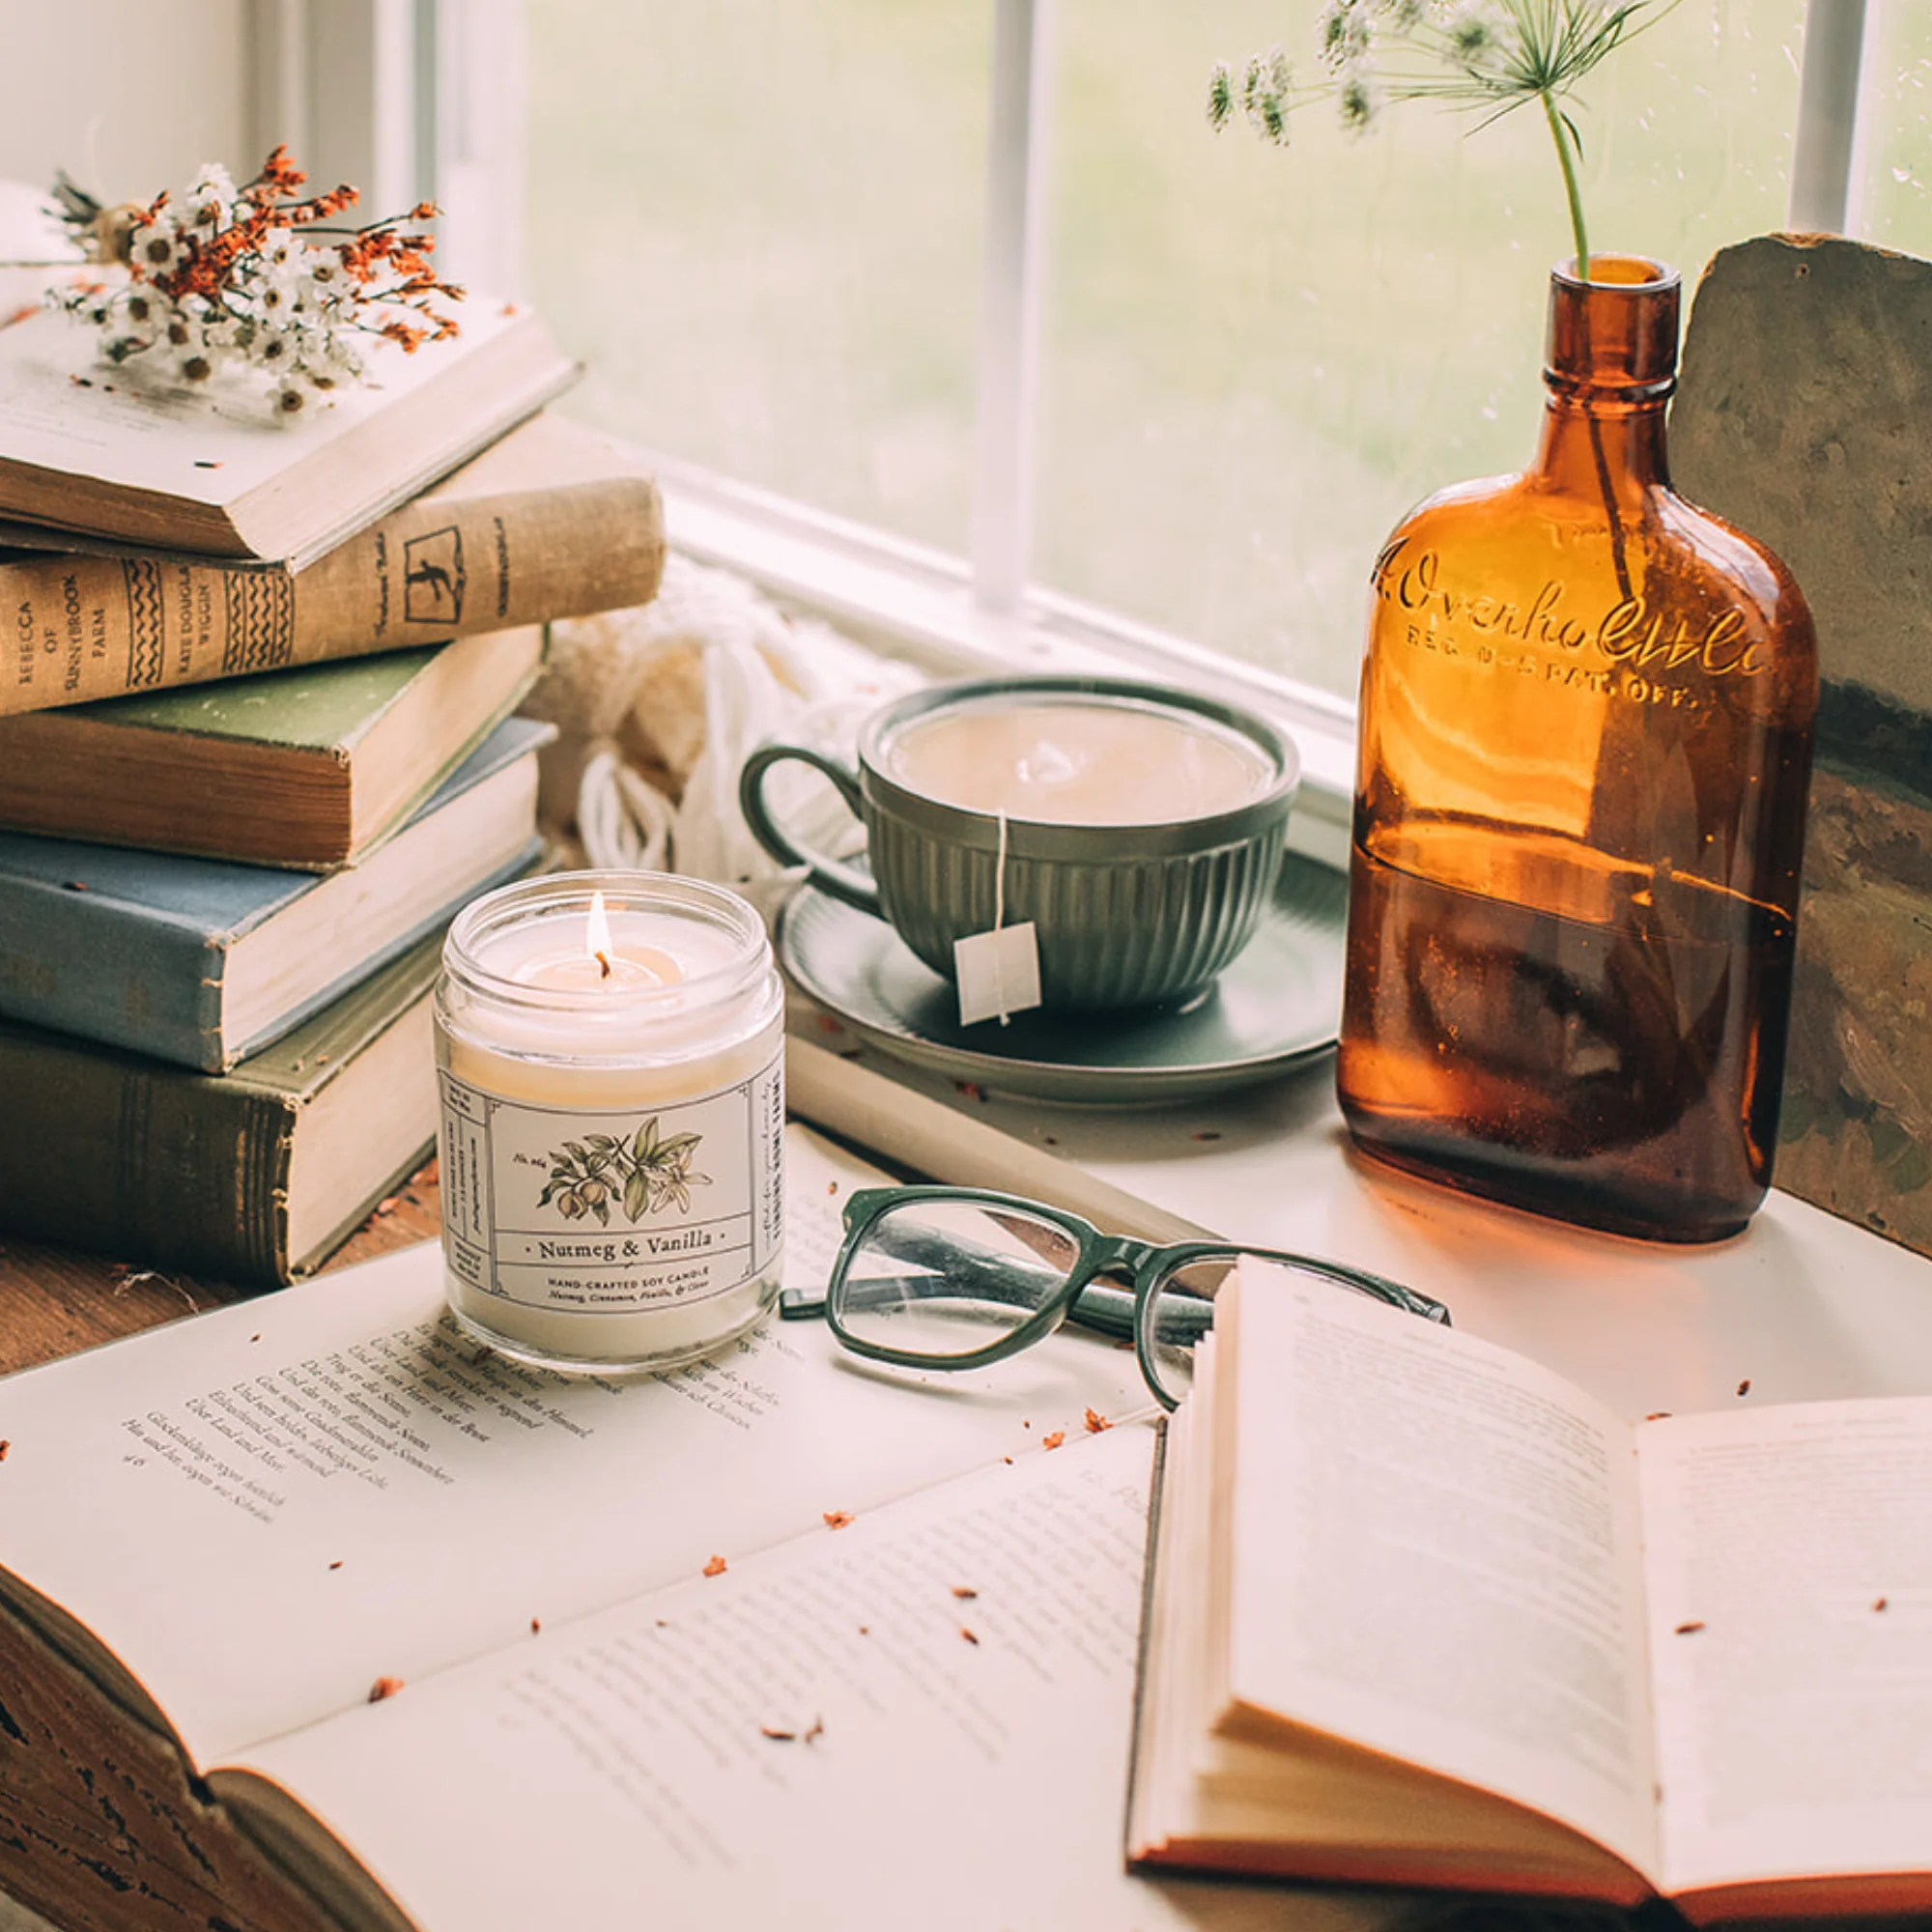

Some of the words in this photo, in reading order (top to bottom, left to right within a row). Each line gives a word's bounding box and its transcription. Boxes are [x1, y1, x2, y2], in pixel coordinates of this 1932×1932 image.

[179, 565, 193, 634] DOUGLA
[43, 627, 59, 654] OF
[92, 609, 106, 658] FARM
[538, 1240, 616, 1262] Nutmeg
[621, 1239, 639, 1257] &
[647, 1230, 712, 1254] Vanilla
[548, 1277, 639, 1290] HAND-CRAFTED
[642, 1276, 663, 1288] SOY
[668, 1265, 709, 1285] CANDLE
